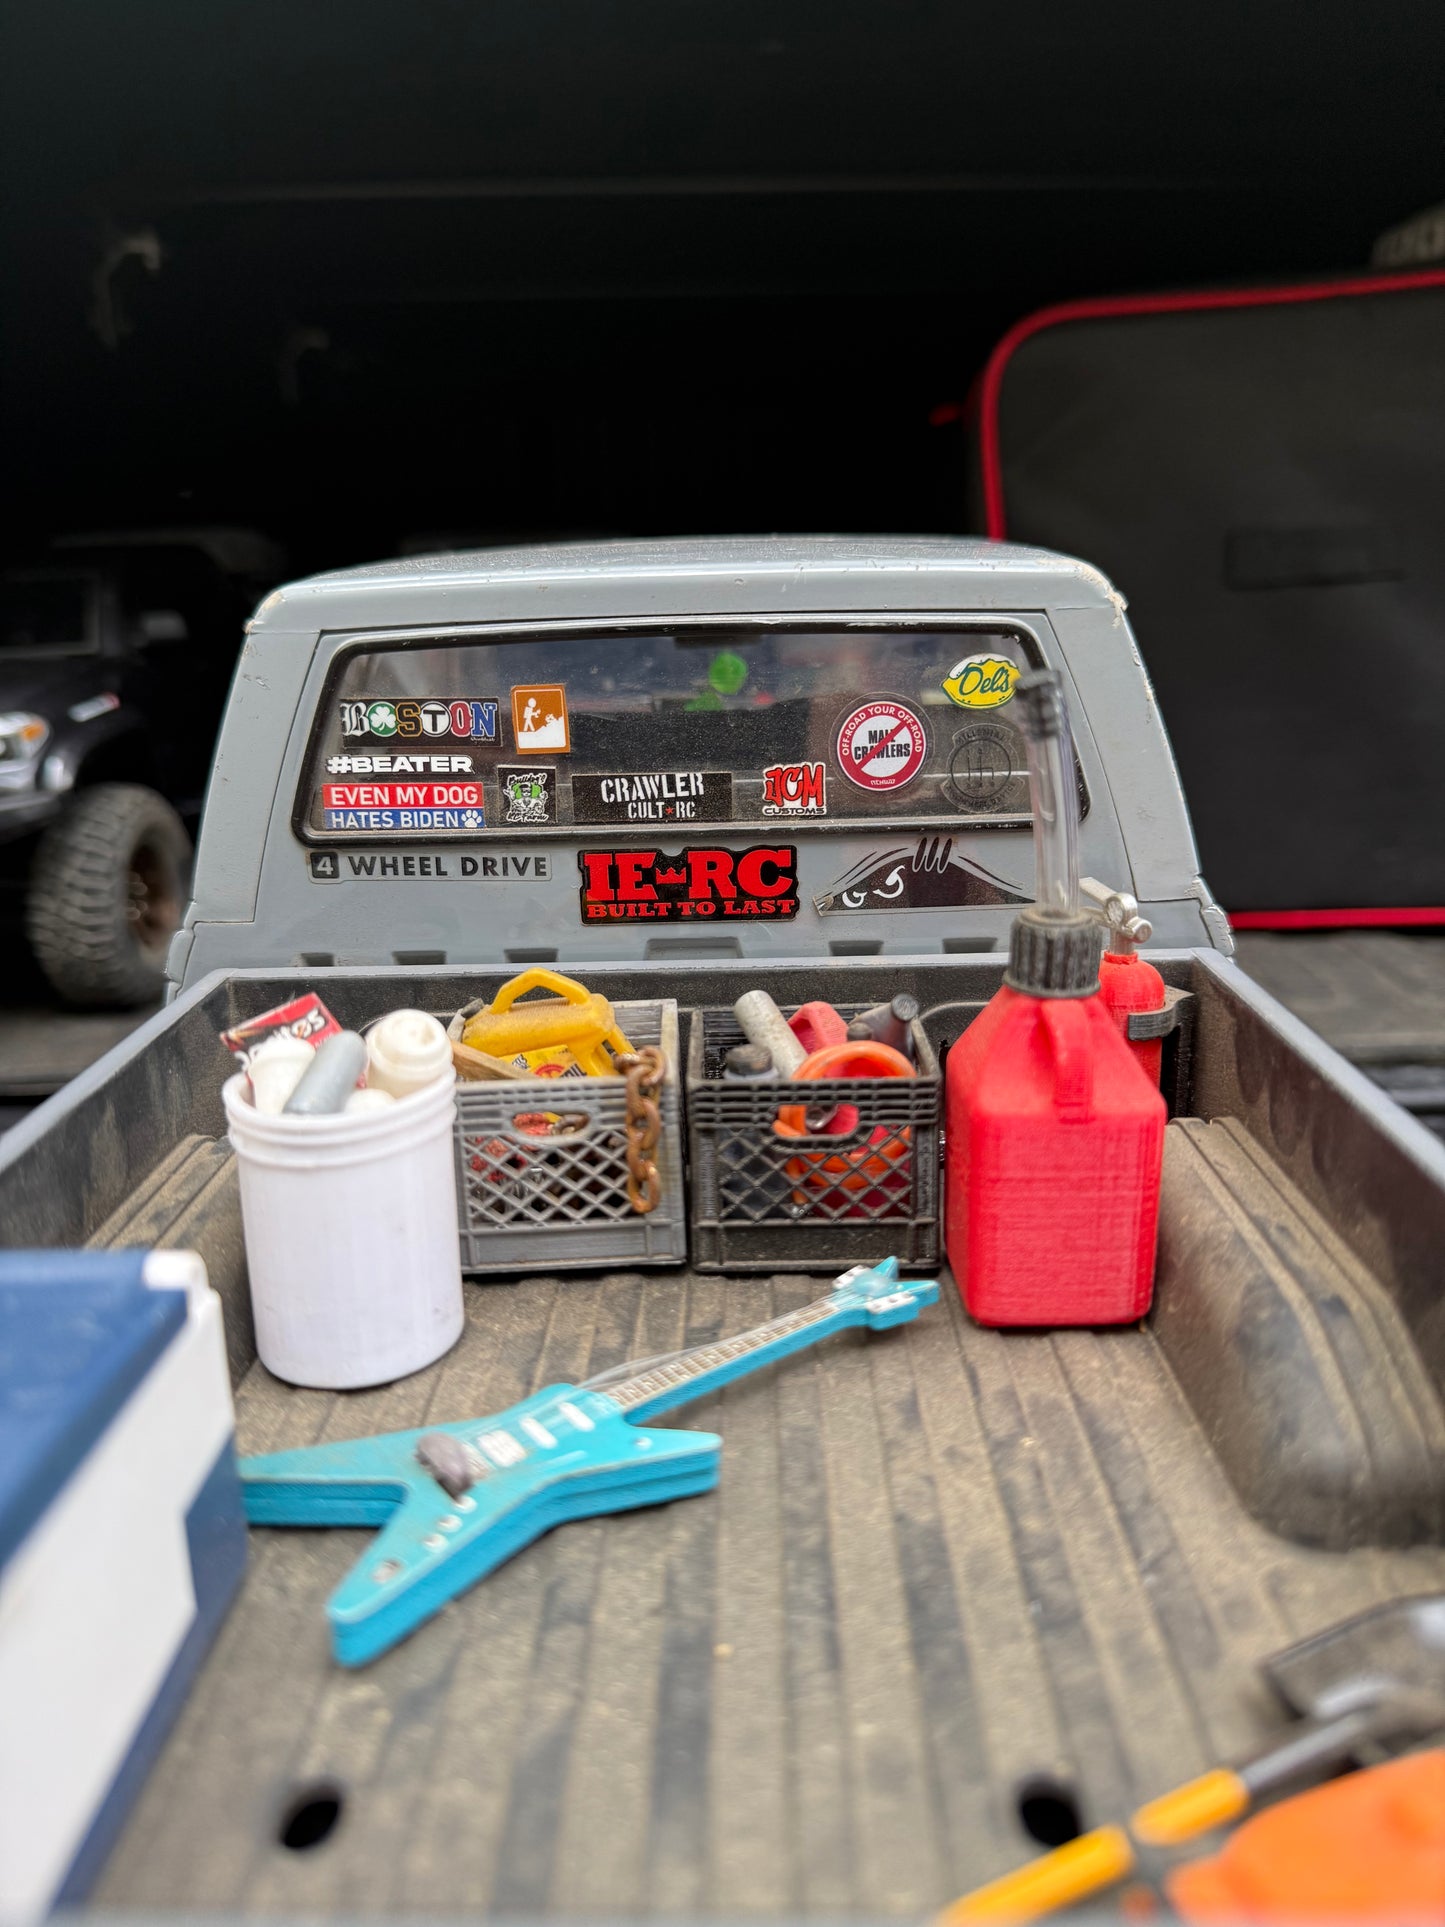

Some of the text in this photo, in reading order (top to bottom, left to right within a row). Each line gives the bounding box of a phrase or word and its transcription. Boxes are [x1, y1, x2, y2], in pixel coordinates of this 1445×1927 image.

[959, 666, 1010, 695] Del's
[842, 706, 923, 756] OFF-ROAD YOUR OFF-ROAD
[854, 743, 911, 760] CRWLERS
[327, 755, 473, 773] #BEATER
[330, 785, 478, 806] EVEN MY DOG
[601, 772, 705, 803] CRAWLER
[628, 801, 696, 819] CULT RC
[764, 806, 825, 815] CUSTOMS
[332, 811, 459, 828] HATES BIDEN
[317, 854, 548, 877] 4 WHEEL DRIVE
[587, 900, 795, 918] BUILT TO LAST
